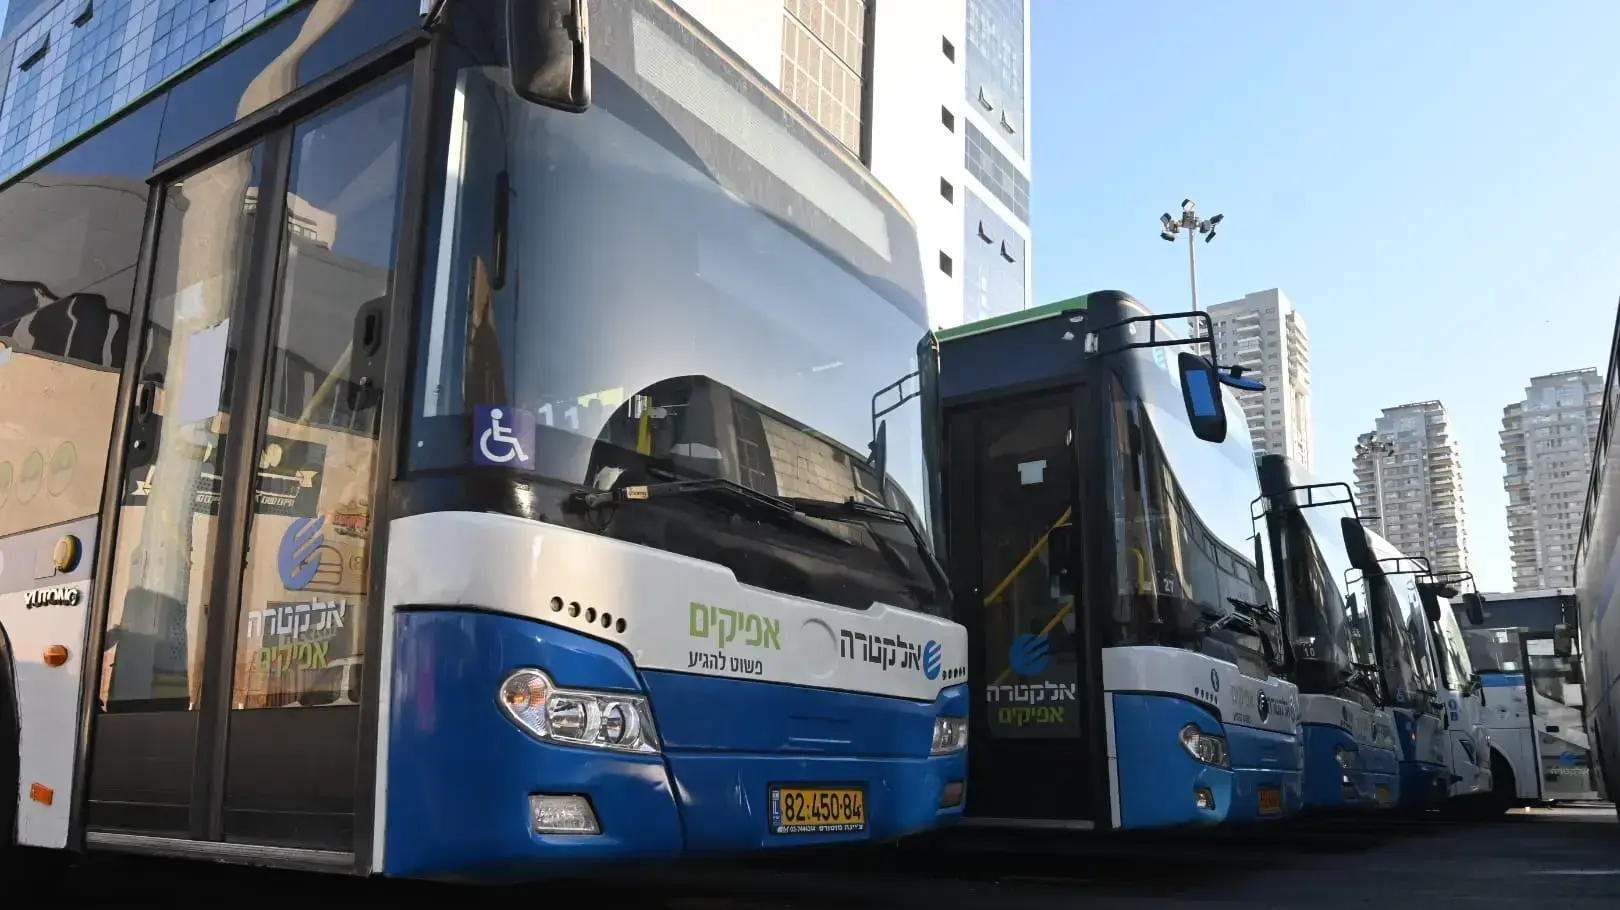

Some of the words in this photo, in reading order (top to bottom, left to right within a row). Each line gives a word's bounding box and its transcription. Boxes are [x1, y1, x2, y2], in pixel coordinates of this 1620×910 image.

[24, 588, 80, 609] YUTONG
[247, 596, 346, 639] אלקטרה
[690, 602, 781, 650] אפיקים
[257, 641, 329, 678] אפיקים
[687, 651, 726, 670] להגיע
[840, 629, 921, 671] אלקטרה
[730, 657, 763, 675] פשוט
[986, 680, 1076, 704] אלקטרה
[998, 707, 1064, 727] אפיקים
